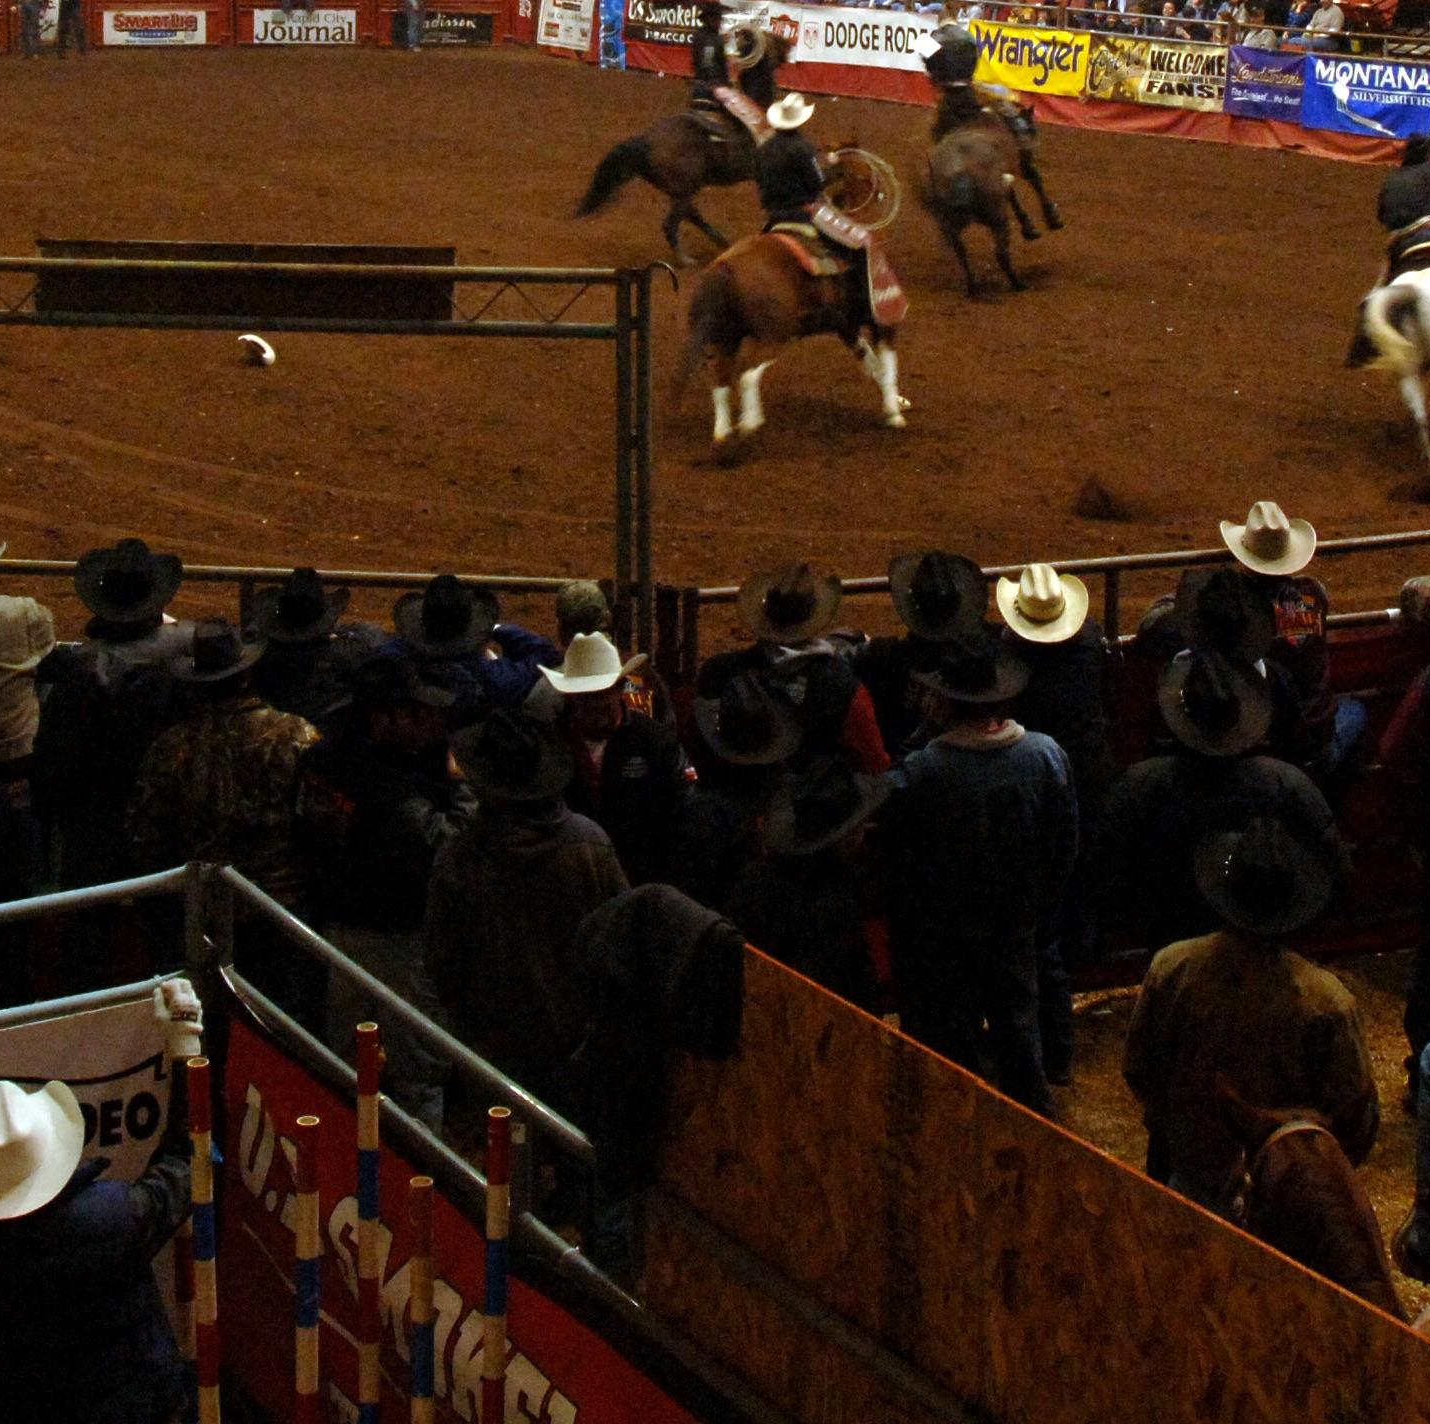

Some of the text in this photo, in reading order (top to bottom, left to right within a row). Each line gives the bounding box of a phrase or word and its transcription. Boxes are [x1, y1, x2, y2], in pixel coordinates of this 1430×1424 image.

[255, 22, 354, 42] Journal
[324, 13, 347, 25] City
[825, 21, 879, 50] DODGE
[975, 24, 1084, 86] Wrangler
[1151, 50, 1225, 76] WELCOME
[1315, 59, 1430, 90] MONTANA
